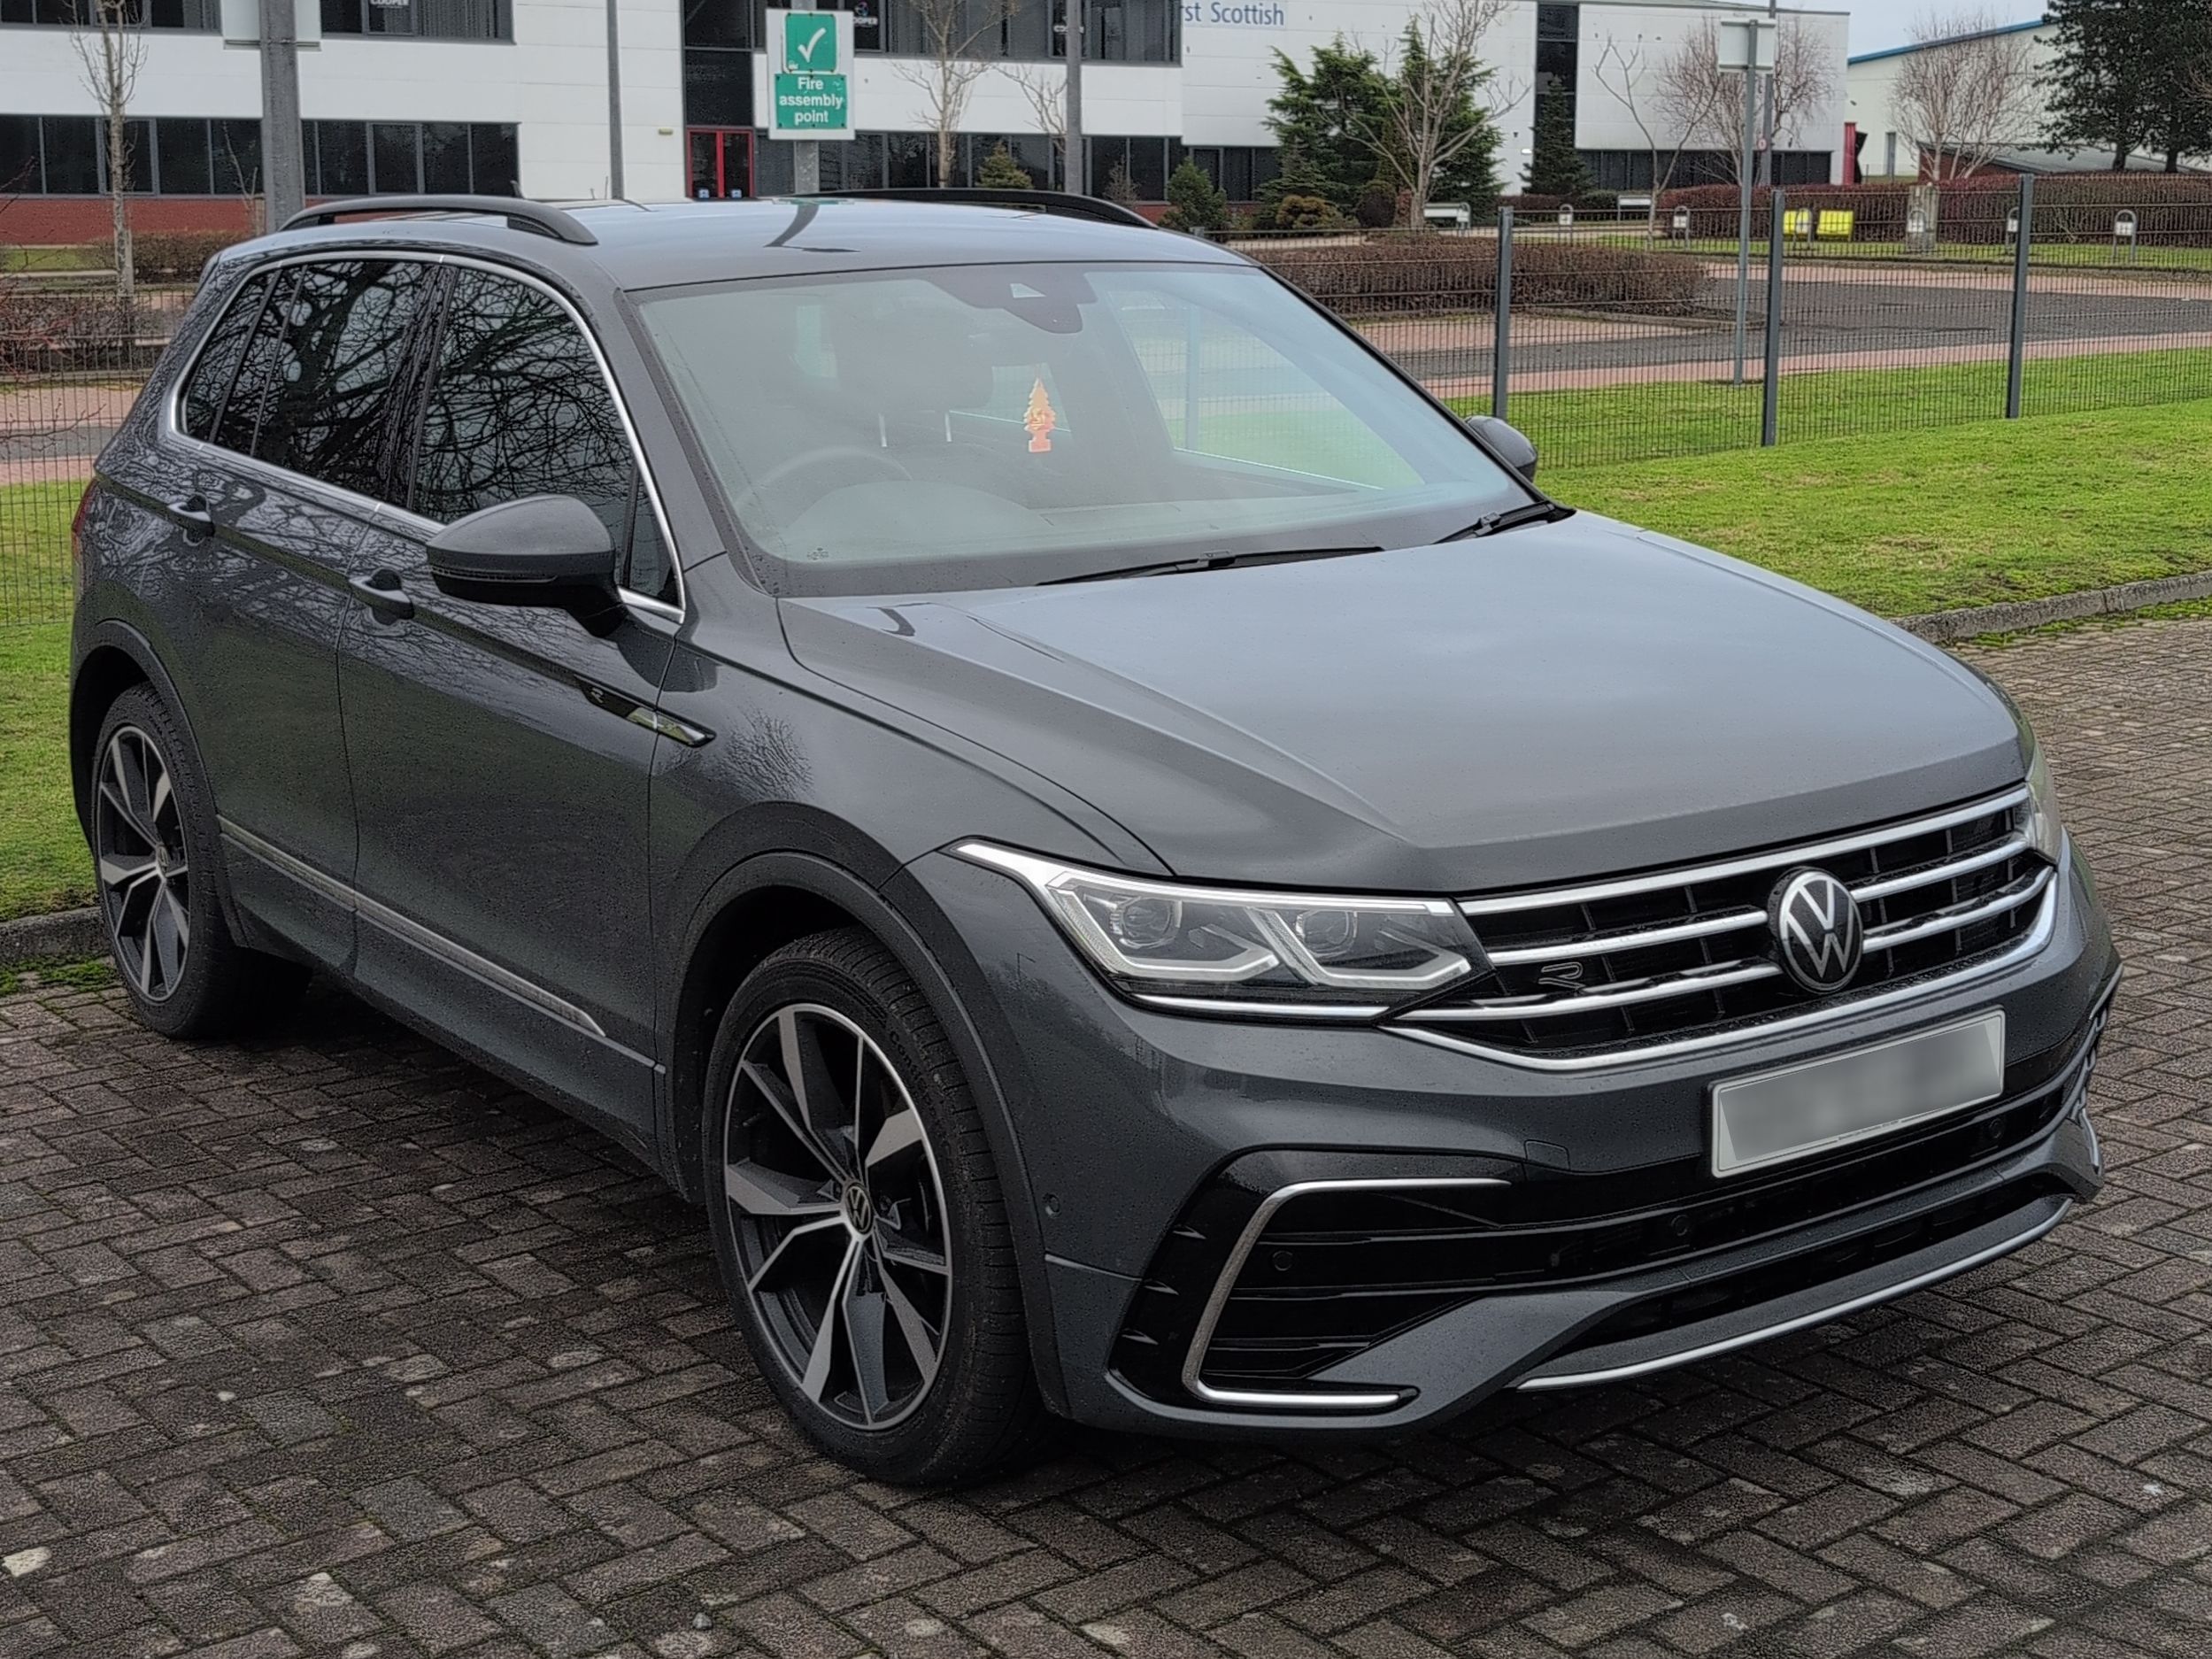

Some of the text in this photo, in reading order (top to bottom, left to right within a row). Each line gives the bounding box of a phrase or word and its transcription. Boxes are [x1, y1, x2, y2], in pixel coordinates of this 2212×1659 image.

[1210, 2, 1284, 26] Scottish
[798, 76, 824, 90] Fire
[779, 94, 844, 110] assembly
[794, 110, 829, 126] point
